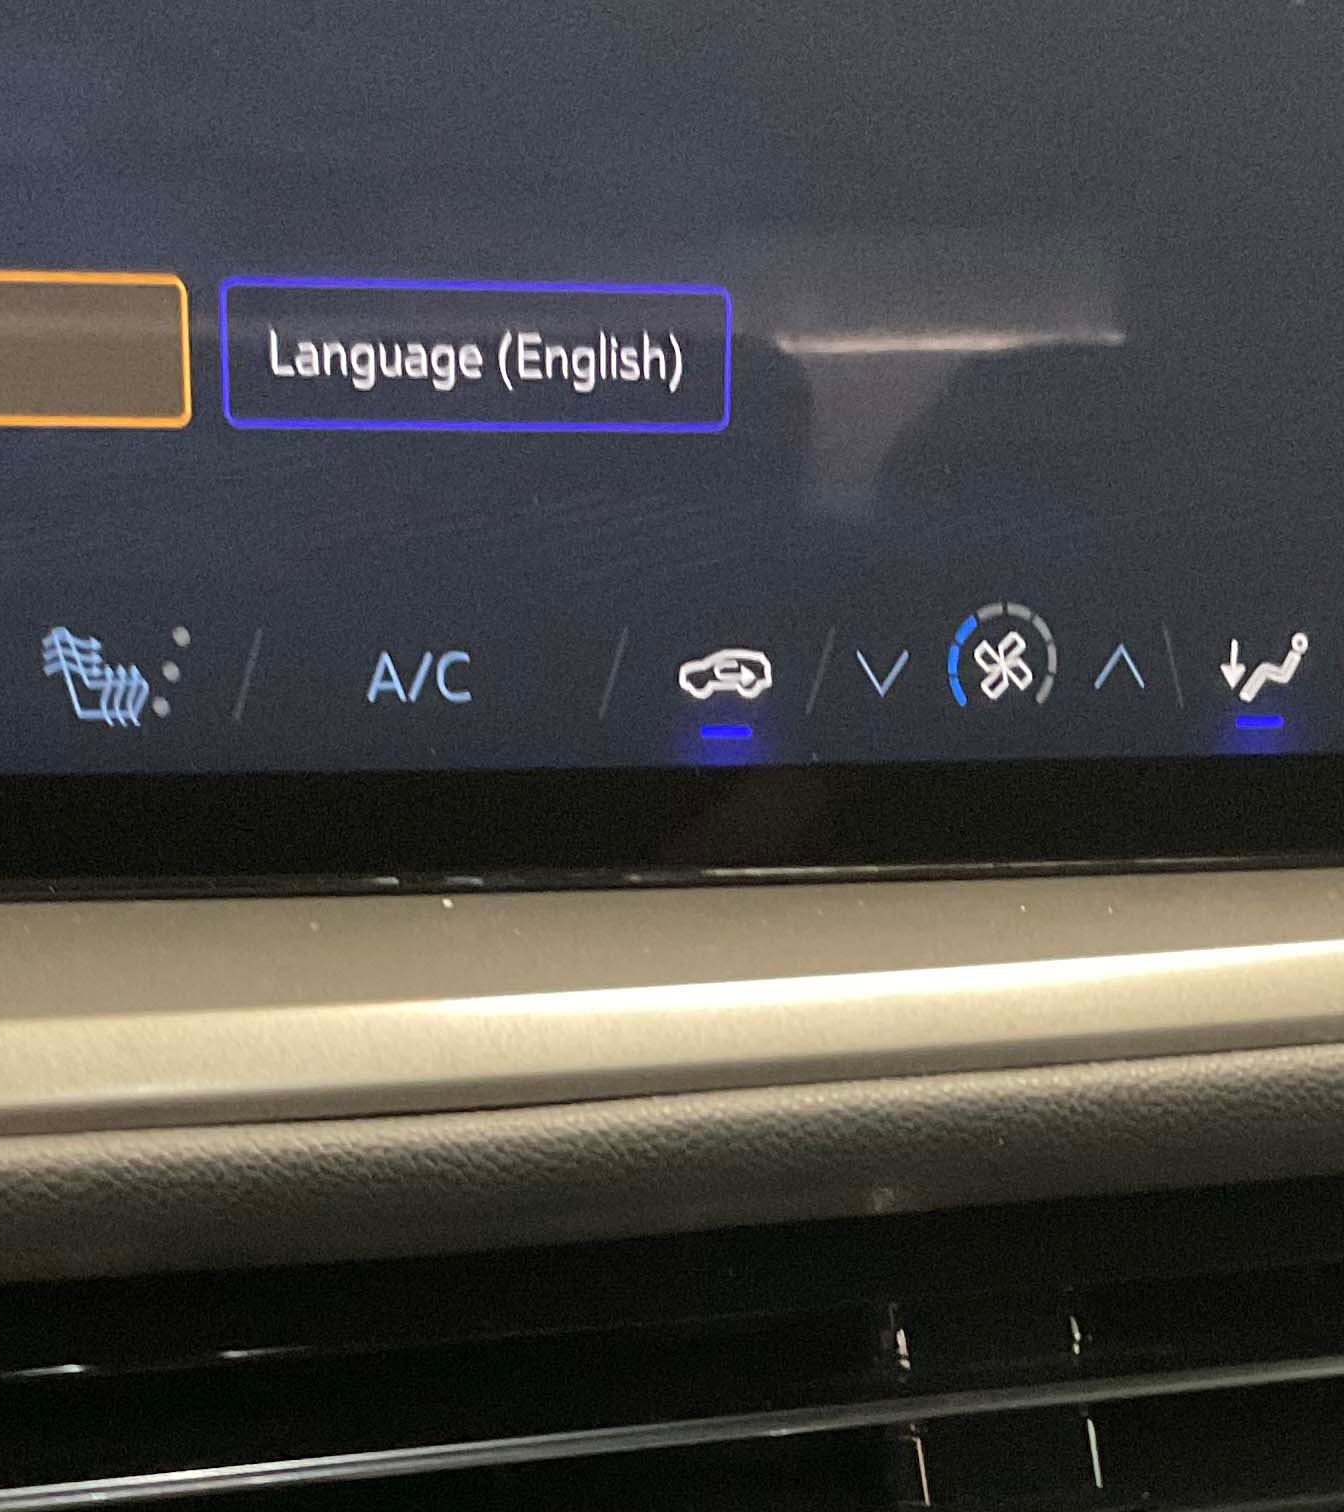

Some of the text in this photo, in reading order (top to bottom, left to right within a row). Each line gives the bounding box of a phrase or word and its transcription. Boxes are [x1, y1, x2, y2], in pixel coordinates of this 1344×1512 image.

[269, 327, 683, 394] Language (English)
[366, 650, 472, 704] A/C
